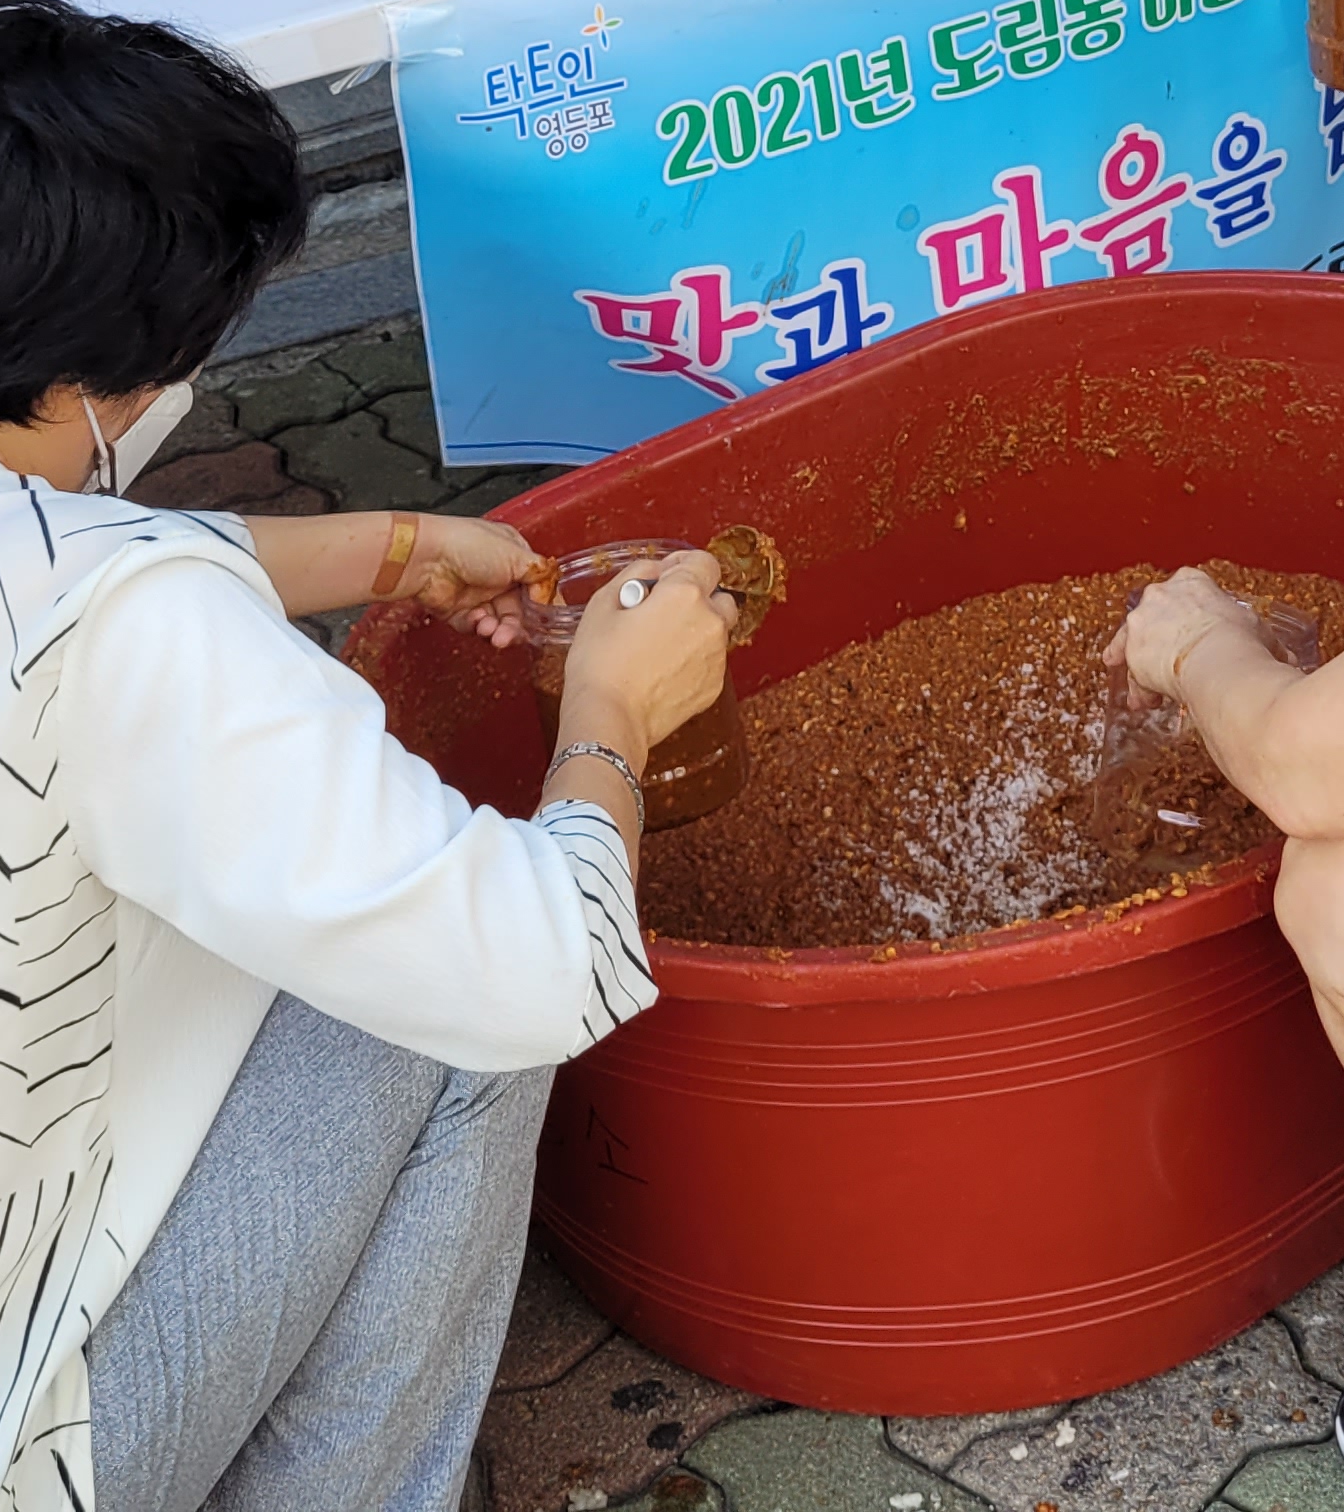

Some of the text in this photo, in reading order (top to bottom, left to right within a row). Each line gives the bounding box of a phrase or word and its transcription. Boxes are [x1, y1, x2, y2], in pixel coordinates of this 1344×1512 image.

[459, 43, 625, 138] 탁트인
[536, 100, 613, 156] 영등포
[660, 40, 911, 180] 2021년
[581, 267, 886, 400] 맛과
[924, 120, 1283, 307] 마음을
